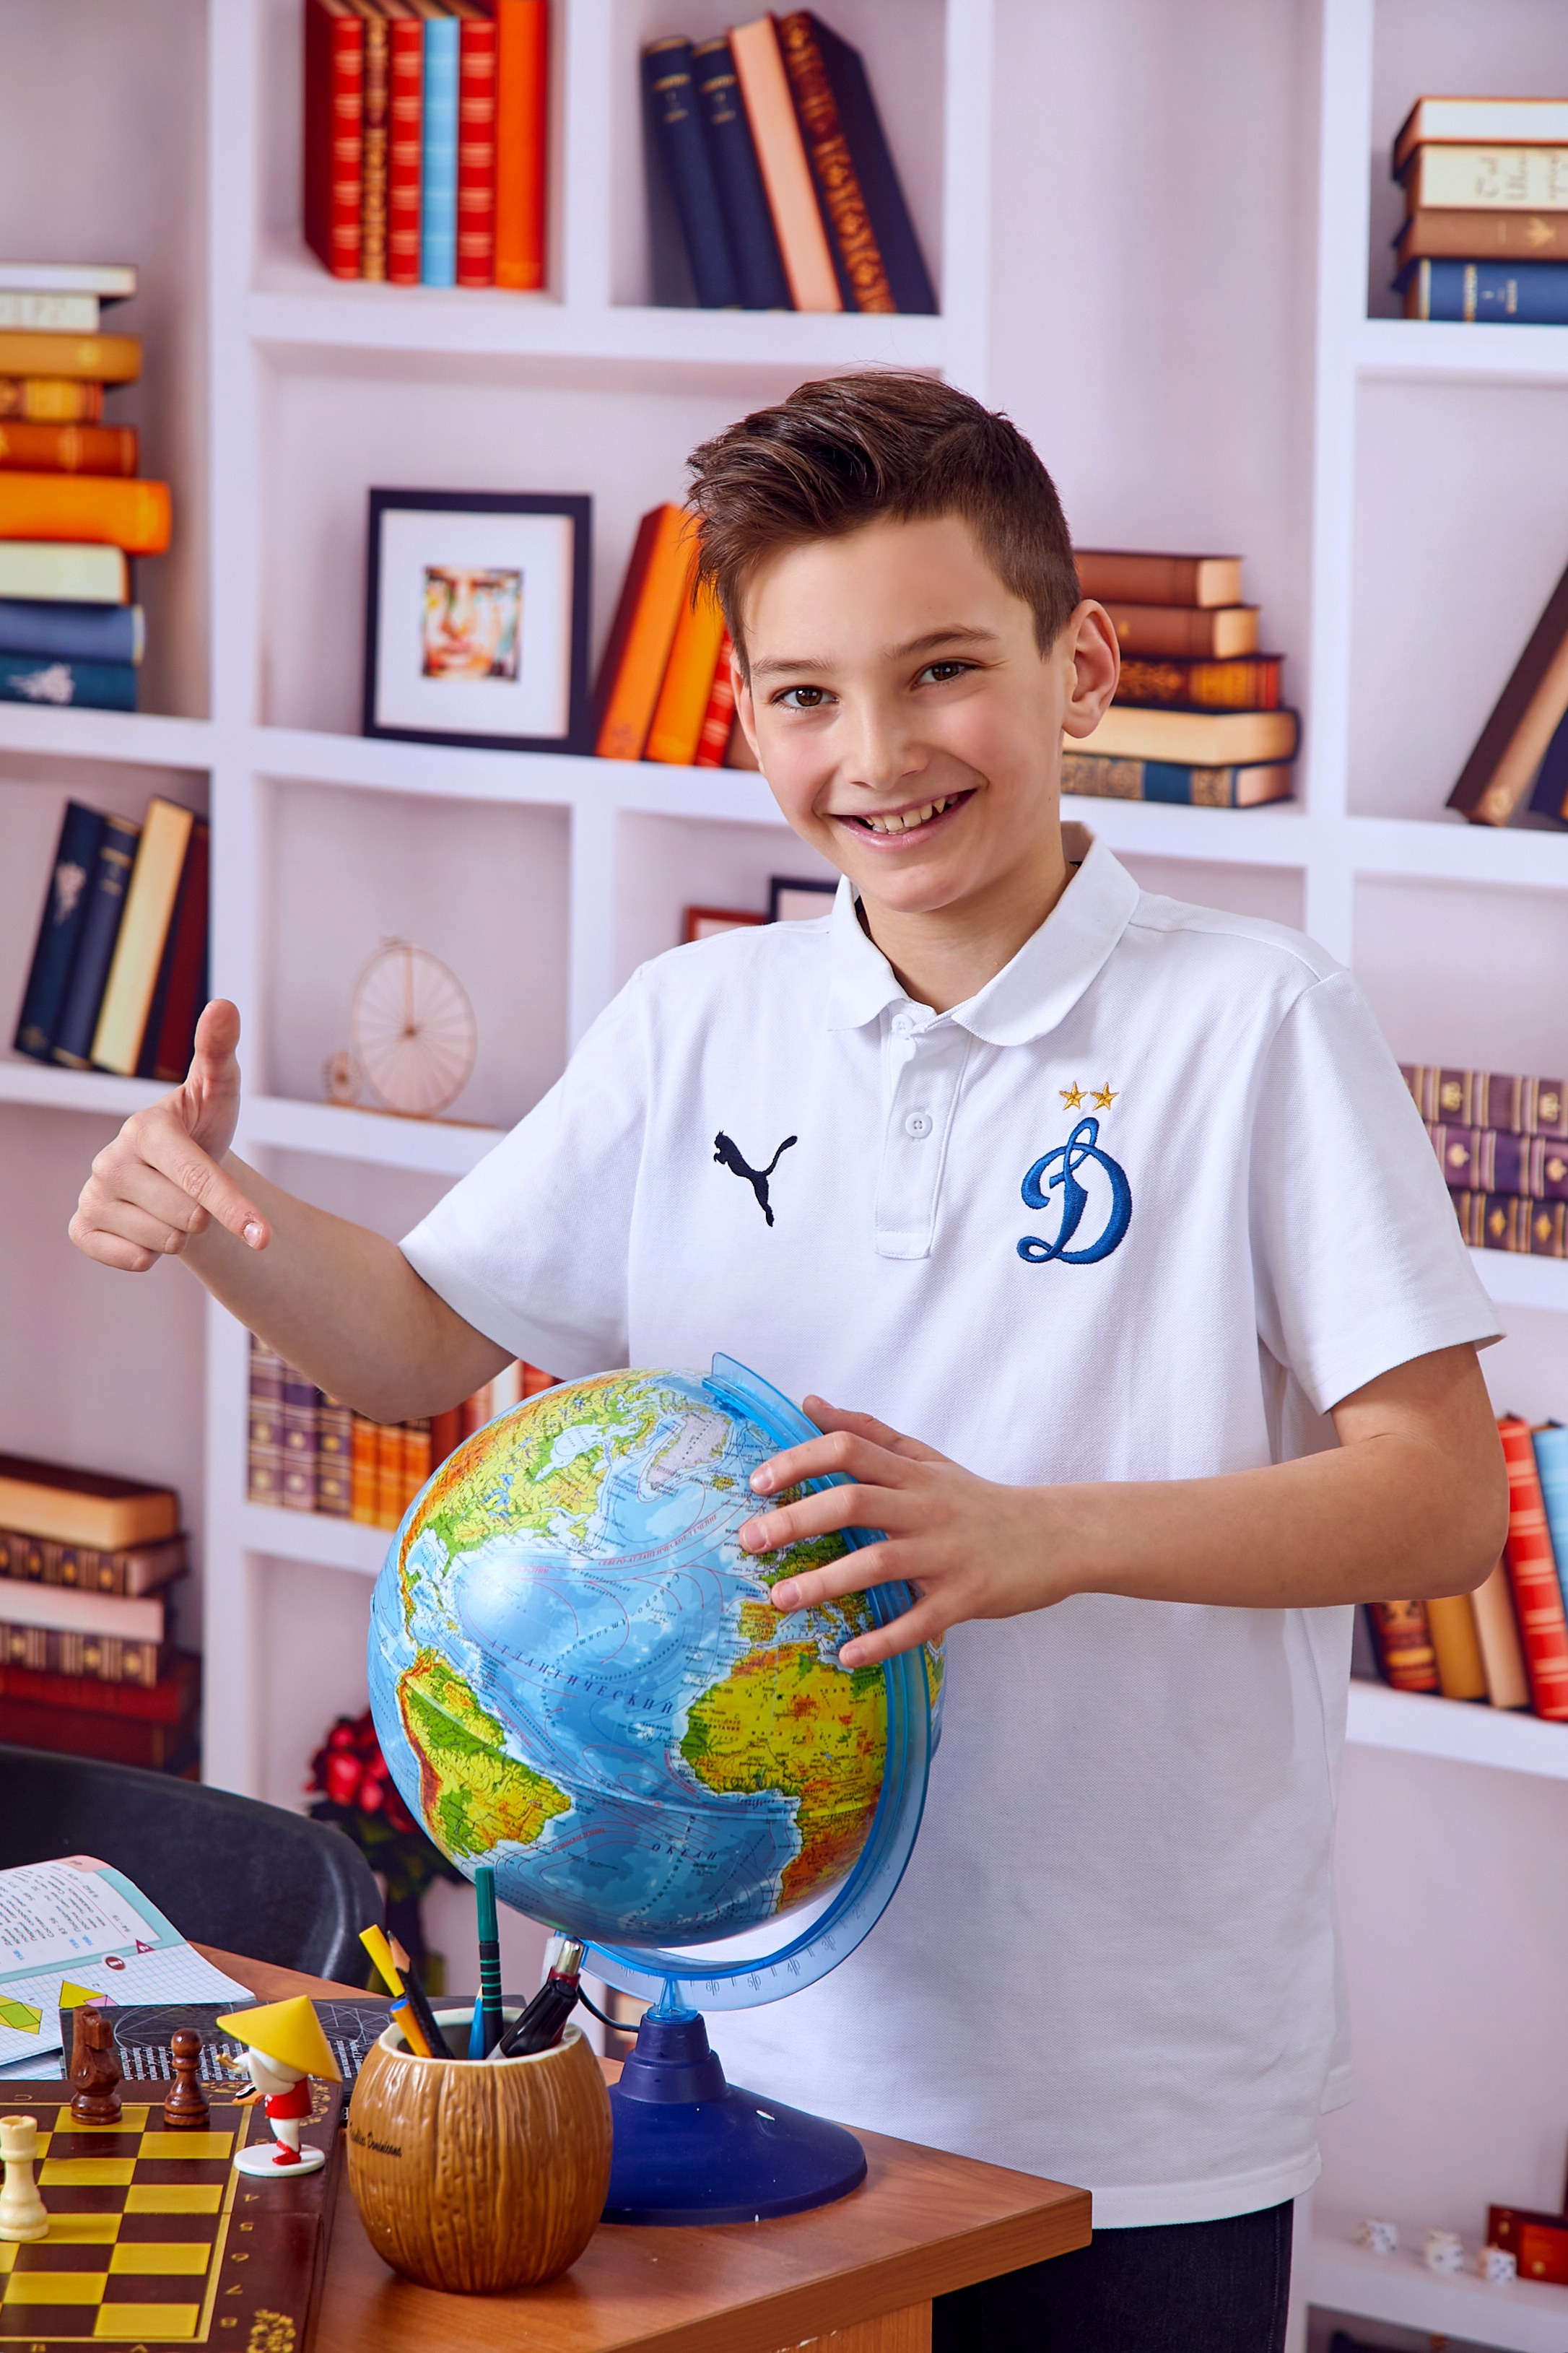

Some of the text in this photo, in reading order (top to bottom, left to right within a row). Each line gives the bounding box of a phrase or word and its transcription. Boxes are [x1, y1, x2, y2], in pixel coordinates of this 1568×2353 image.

[689, 1515, 718, 1536] ТЕЧЕНИЕ
[489, 1640, 674, 1714] АТЛАНТИЧЕСКИЙ
[652, 1843, 718, 1861] ОКЕАН
